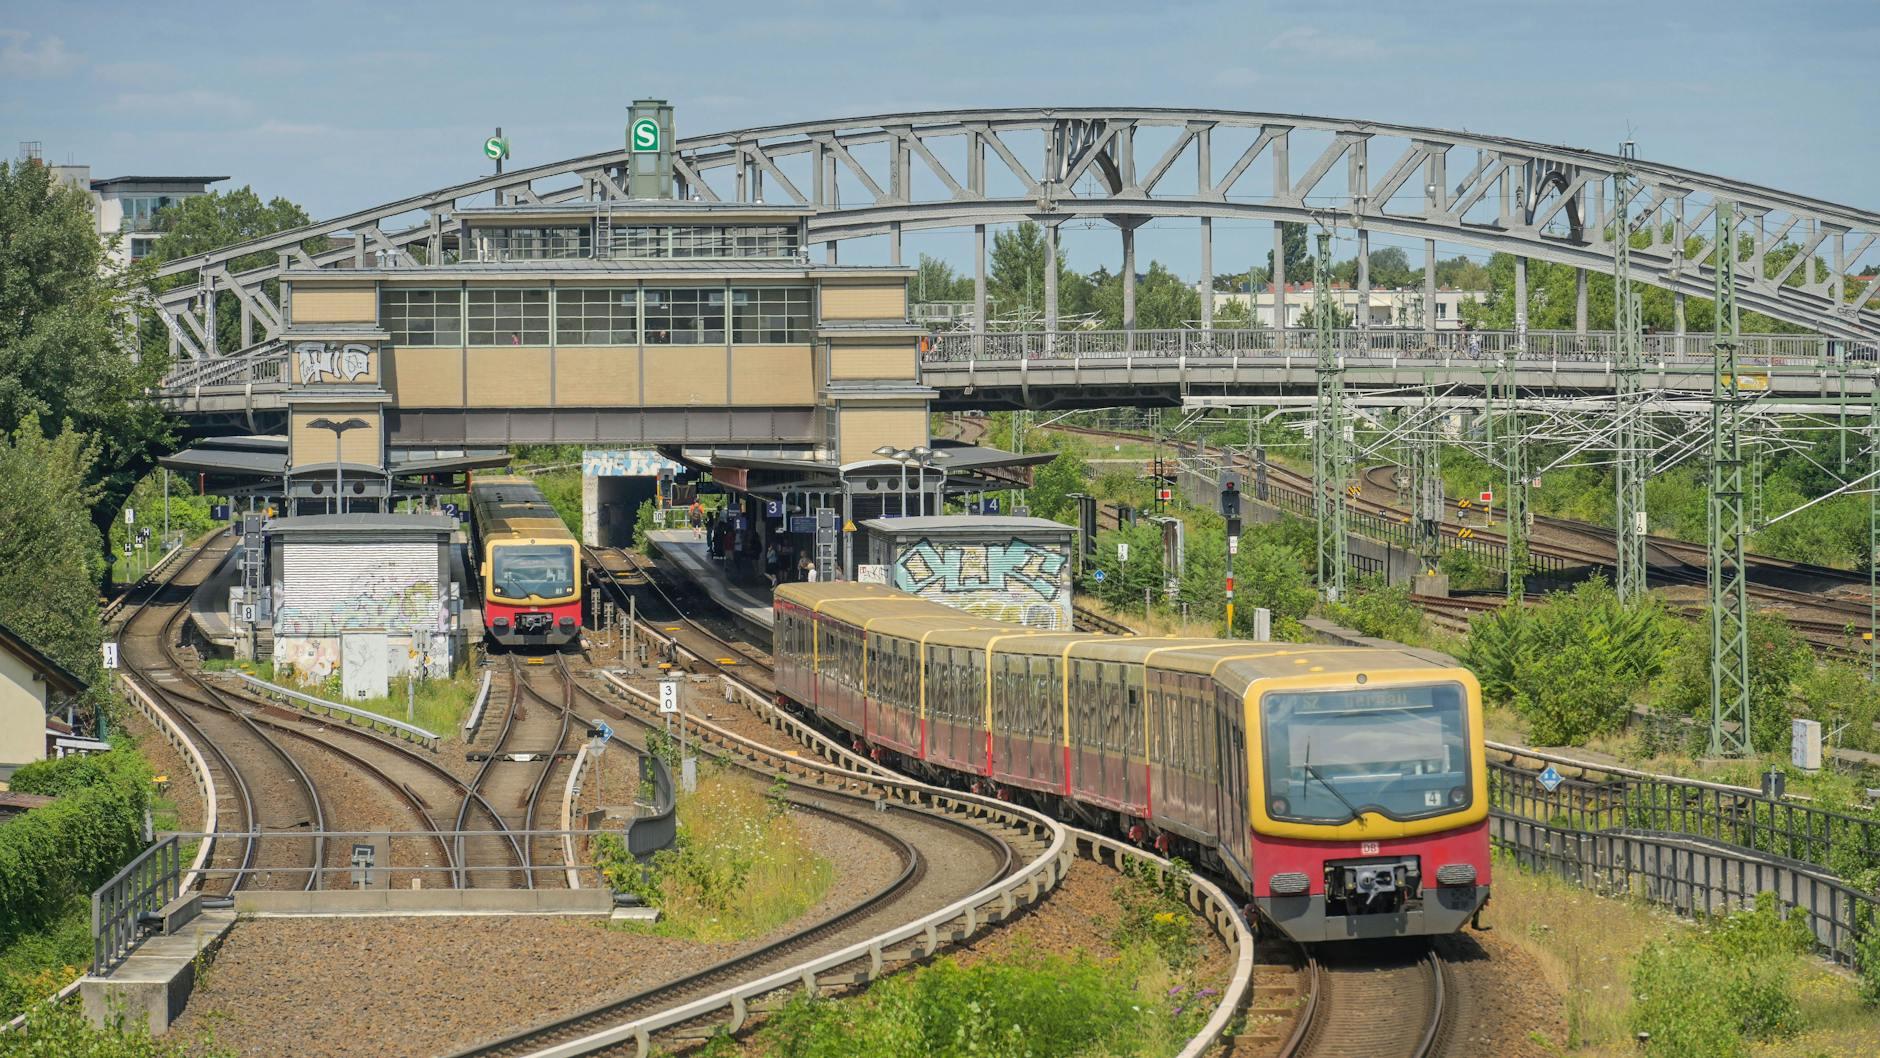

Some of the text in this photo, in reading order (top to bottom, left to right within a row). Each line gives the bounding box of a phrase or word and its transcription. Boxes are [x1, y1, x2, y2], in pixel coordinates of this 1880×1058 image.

[636, 123, 656, 147] S
[487, 138, 502, 158] S
[446, 504, 455, 516] 2
[769, 501, 777, 514] 3
[989, 498, 998, 511] 4
[215, 505, 221, 518] 1
[143, 528, 150, 536] H
[1636, 523, 1643, 533] 6
[135, 536, 142, 544] H
[125, 543, 132, 551] H
[245, 606, 252, 620] 8
[665, 685, 672, 696] 3
[665, 698, 672, 709] 0
[1429, 791, 1437, 804] 4
[1363, 843, 1378, 854] DB
